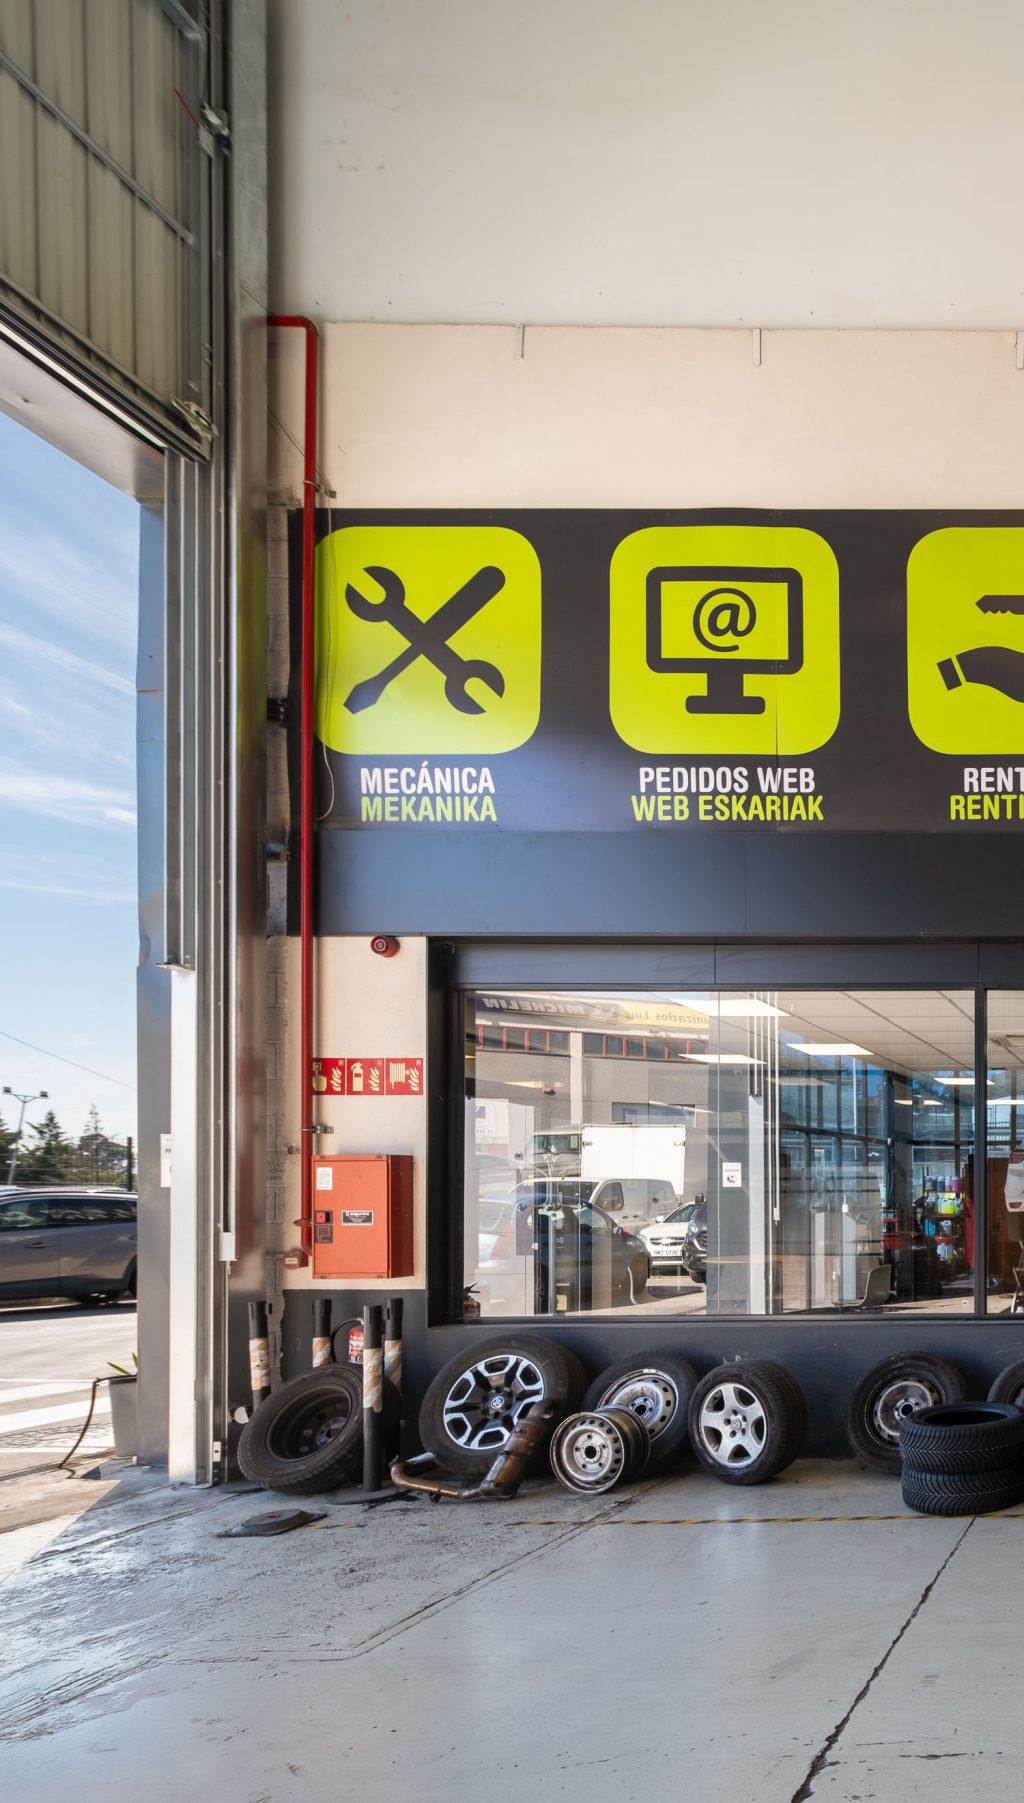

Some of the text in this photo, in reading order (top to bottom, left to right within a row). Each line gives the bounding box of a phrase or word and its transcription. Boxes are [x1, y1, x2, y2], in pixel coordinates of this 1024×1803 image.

[360, 760, 496, 794] MECÁNICA
[640, 767, 816, 793] PEDIDOS WEB
[361, 796, 497, 822] MEKANIKA
[631, 795, 824, 821] WEB ESKARIAK
